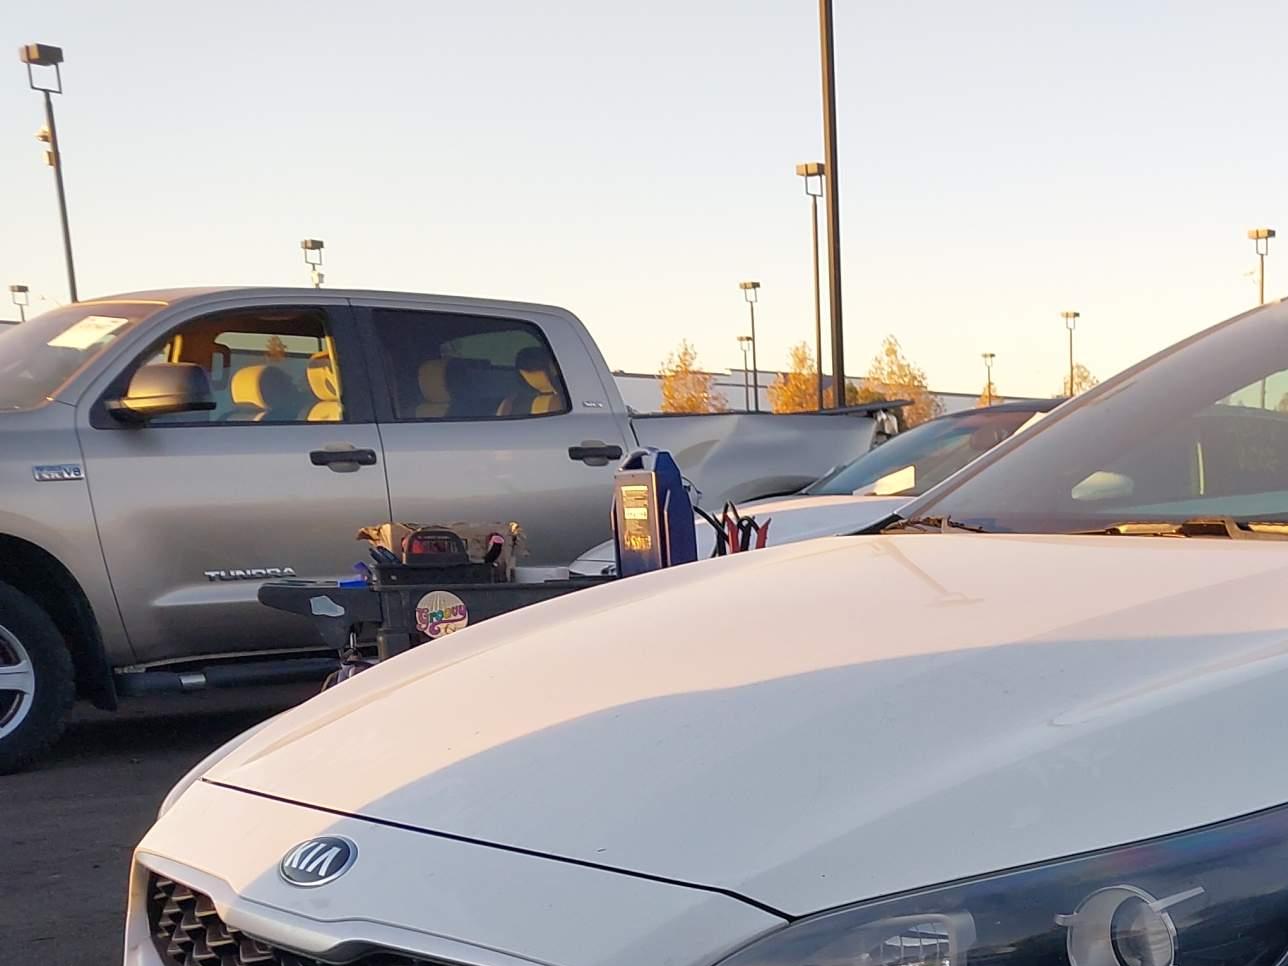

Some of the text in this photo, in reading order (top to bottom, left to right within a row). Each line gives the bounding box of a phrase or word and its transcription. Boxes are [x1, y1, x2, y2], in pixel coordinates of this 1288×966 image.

[204, 567, 297, 582] TUNDRA
[416, 604, 467, 633] Groovy
[284, 840, 342, 877] KIA
